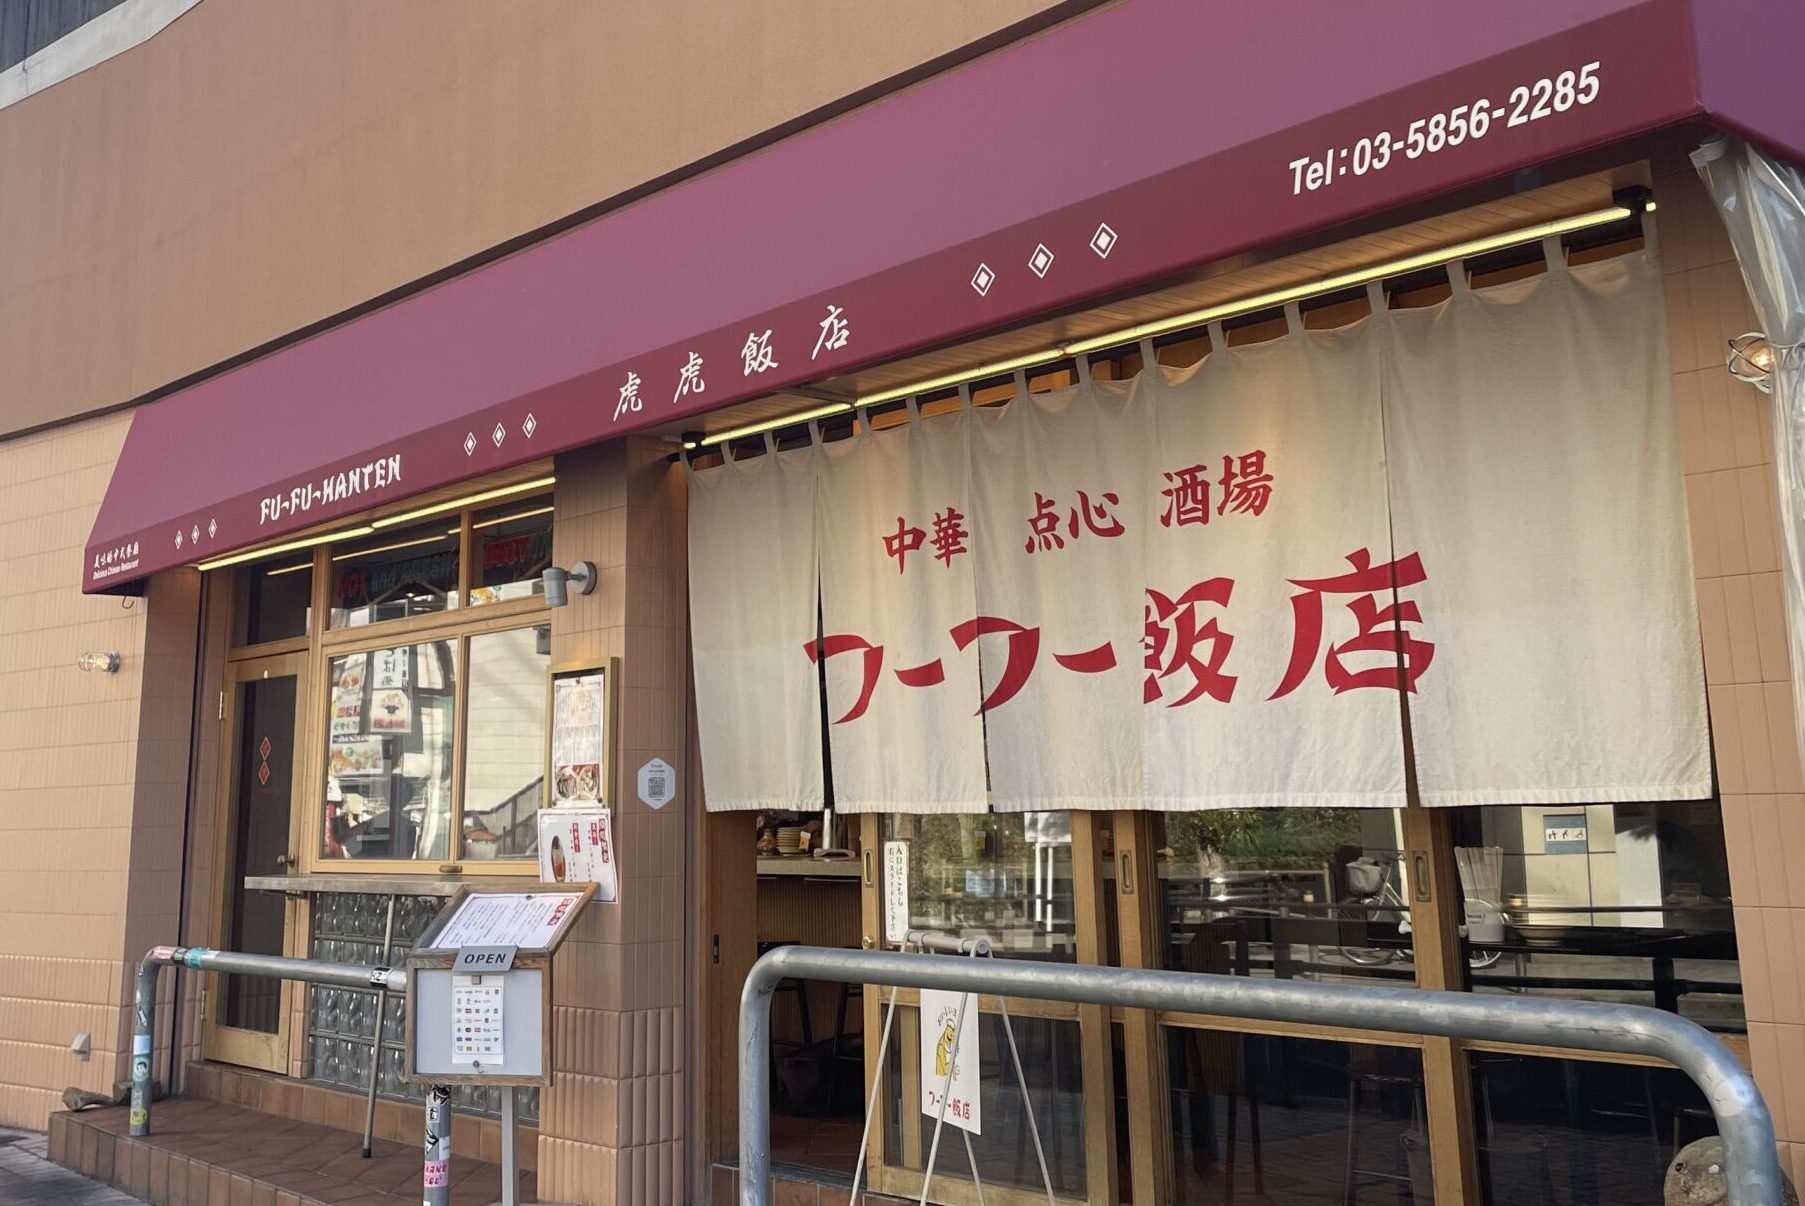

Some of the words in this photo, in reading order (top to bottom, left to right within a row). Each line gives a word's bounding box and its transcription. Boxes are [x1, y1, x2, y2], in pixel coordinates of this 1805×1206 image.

[613, 303, 850, 421] 虎虎飯店
[259, 454, 401, 525] FU-FU-HANTEN
[882, 507, 970, 575] 中華
[1025, 491, 1126, 554] 点心
[1160, 449, 1274, 527] 酒場
[803, 547, 1435, 724] フーフー飯店
[463, 953, 507, 964] OPEN
[928, 1090, 971, 1121] フーー飯店
